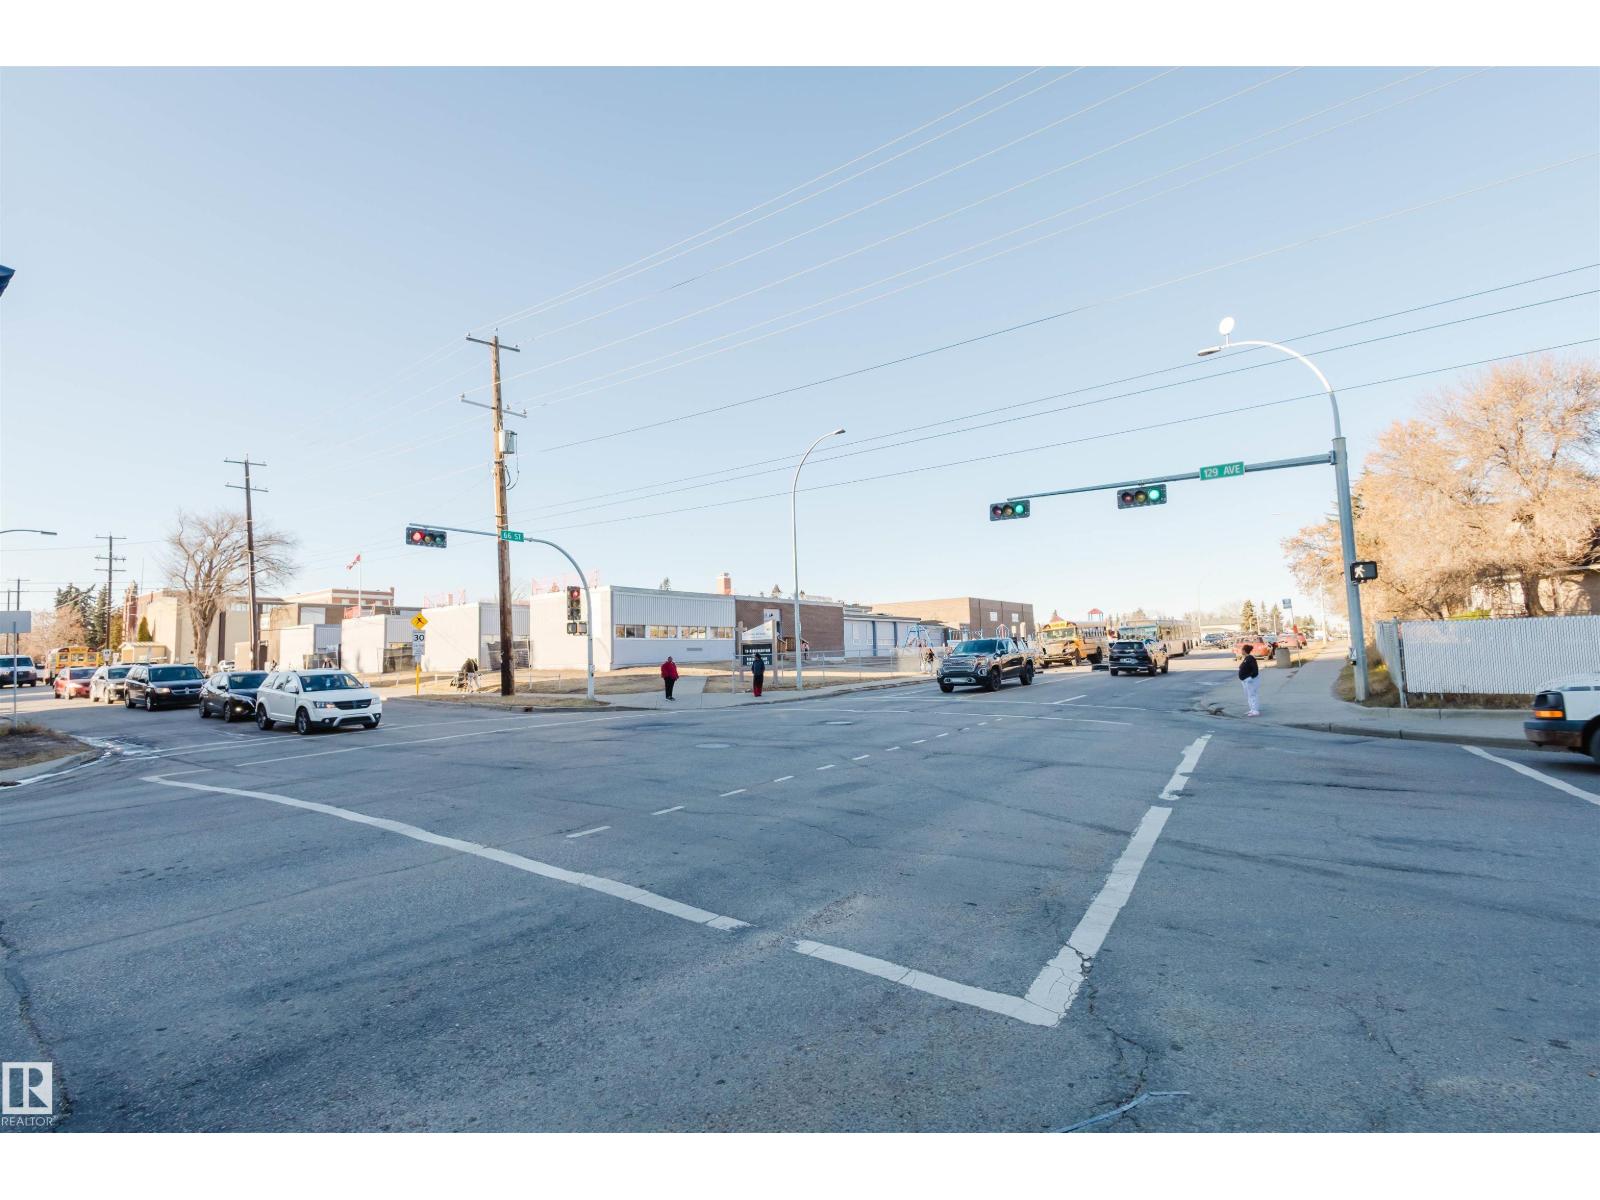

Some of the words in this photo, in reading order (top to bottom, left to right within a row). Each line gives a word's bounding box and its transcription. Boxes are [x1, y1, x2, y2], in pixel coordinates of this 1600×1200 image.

[1203, 467, 1218, 478] 129
[1223, 464, 1241, 475] AVE
[414, 634, 425, 642] 30
